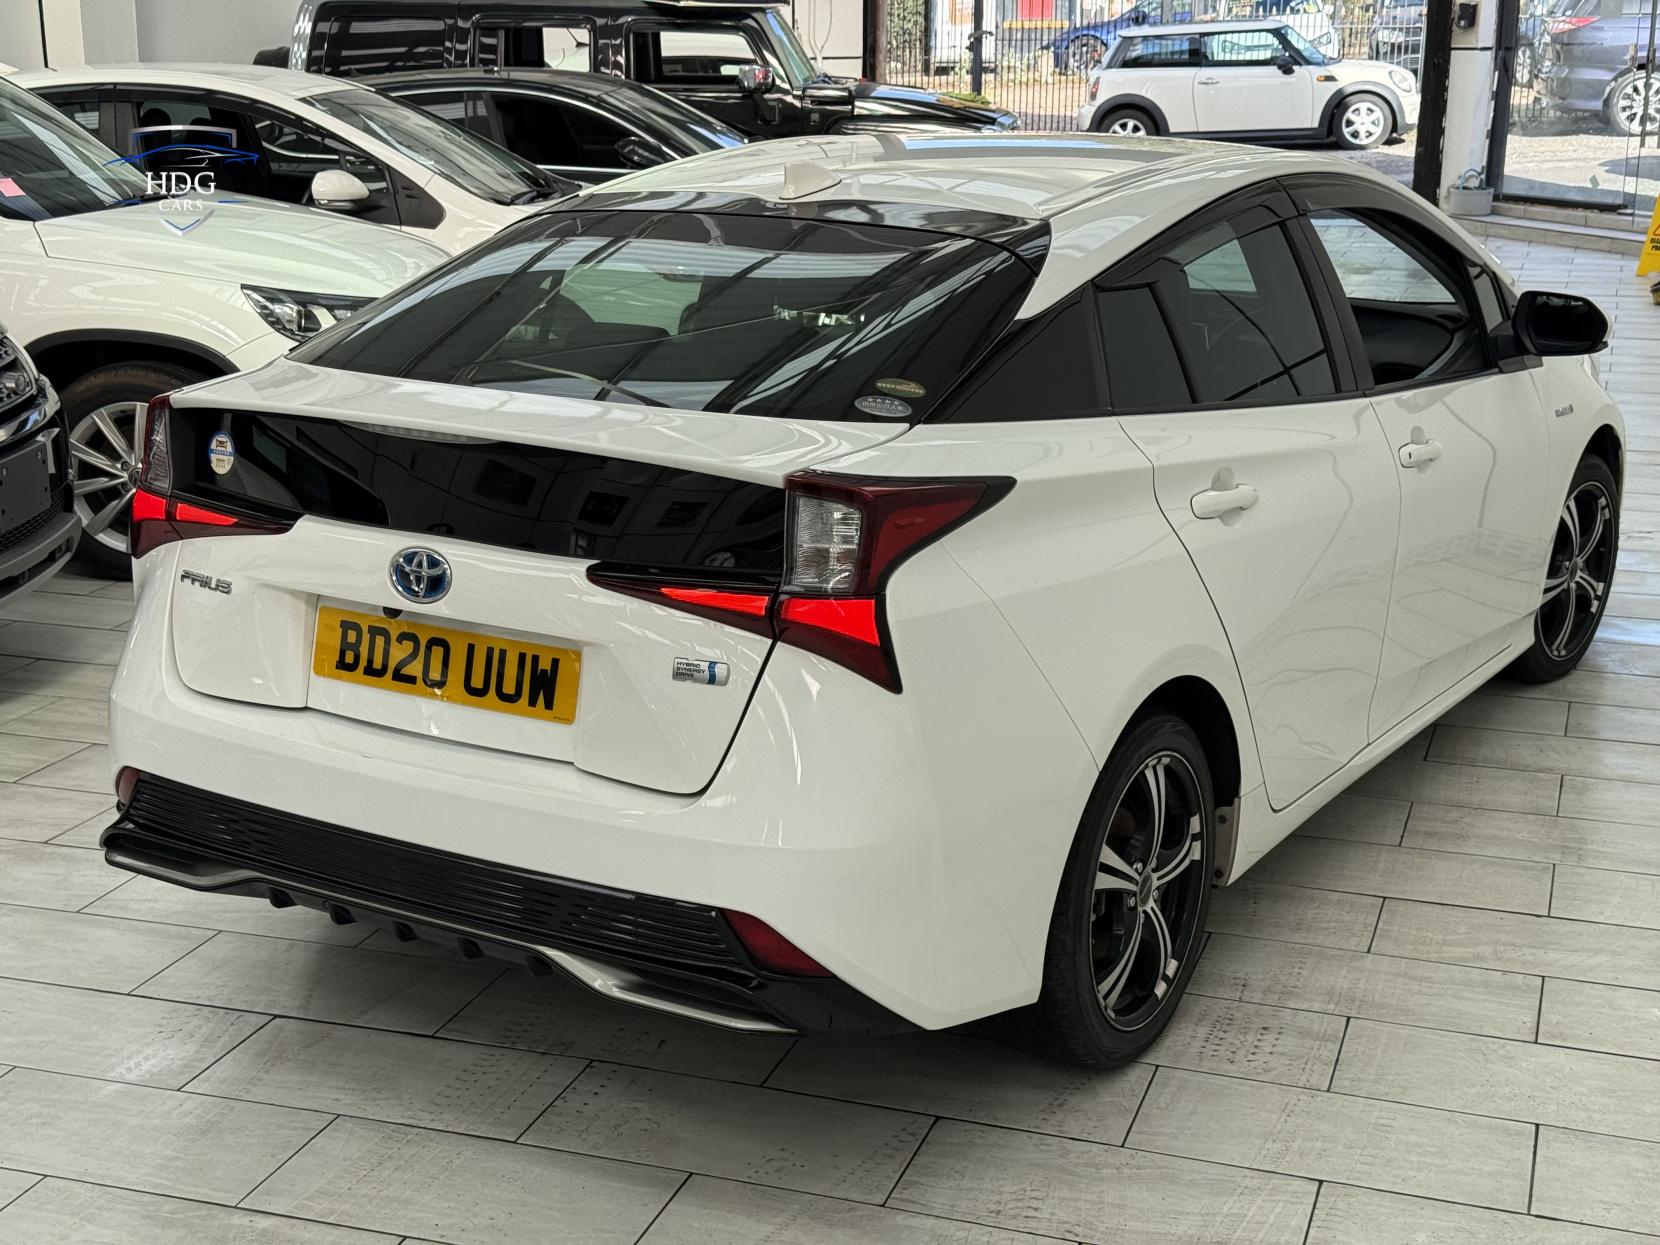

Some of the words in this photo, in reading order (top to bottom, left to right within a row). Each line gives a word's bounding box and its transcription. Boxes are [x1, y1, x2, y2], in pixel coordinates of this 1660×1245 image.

[181, 569, 232, 595] PRIUS
[335, 619, 451, 689] BD20
[463, 643, 560, 711] UUW
[676, 661, 701, 669] HYBRID
[676, 666, 706, 675] SYNERGY
